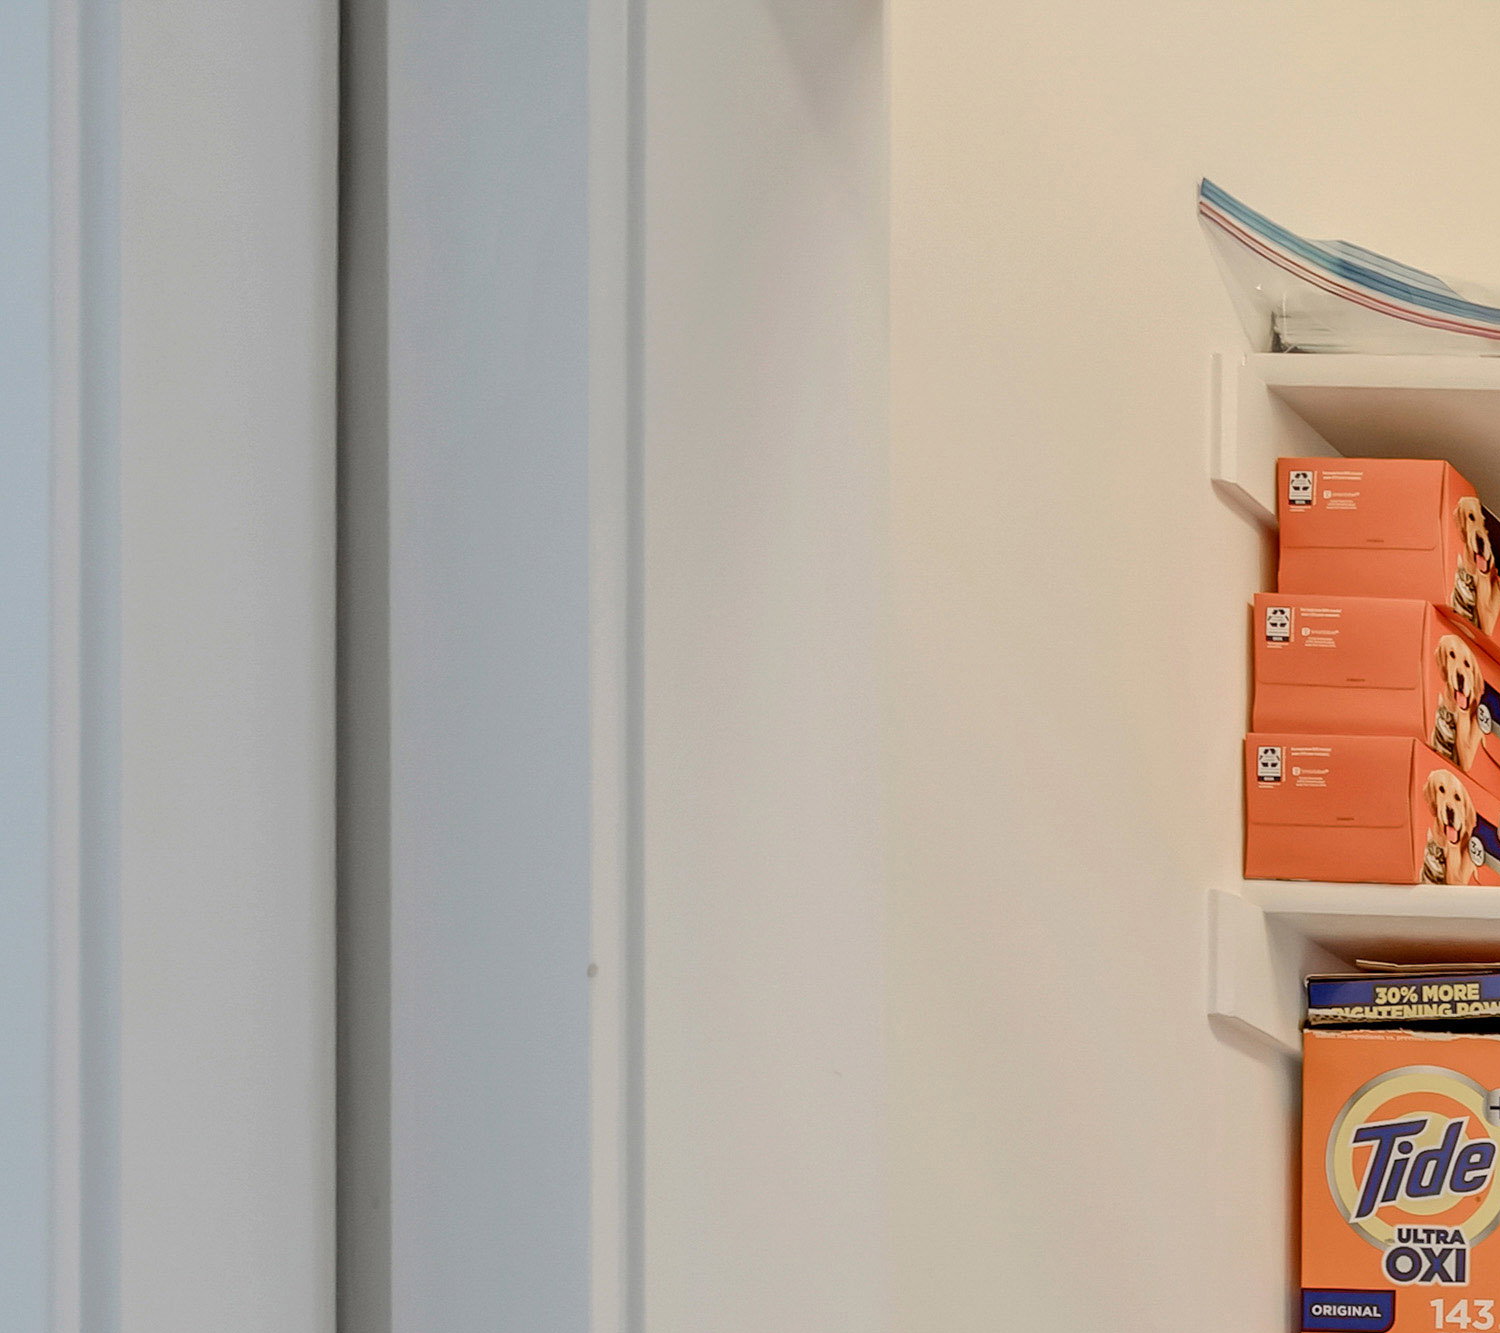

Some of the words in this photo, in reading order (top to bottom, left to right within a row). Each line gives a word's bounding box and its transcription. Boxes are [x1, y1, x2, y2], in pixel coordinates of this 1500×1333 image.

[1375, 986, 1418, 1004] 30%
[1422, 983, 1480, 1001] MORE
[1351, 1117, 1497, 1221] Tide
[1397, 1228, 1465, 1245] ULTRA
[1385, 1246, 1466, 1283] OXI
[1311, 1304, 1382, 1318] ORIGINAL
[1431, 1299, 1494, 1330] 143
